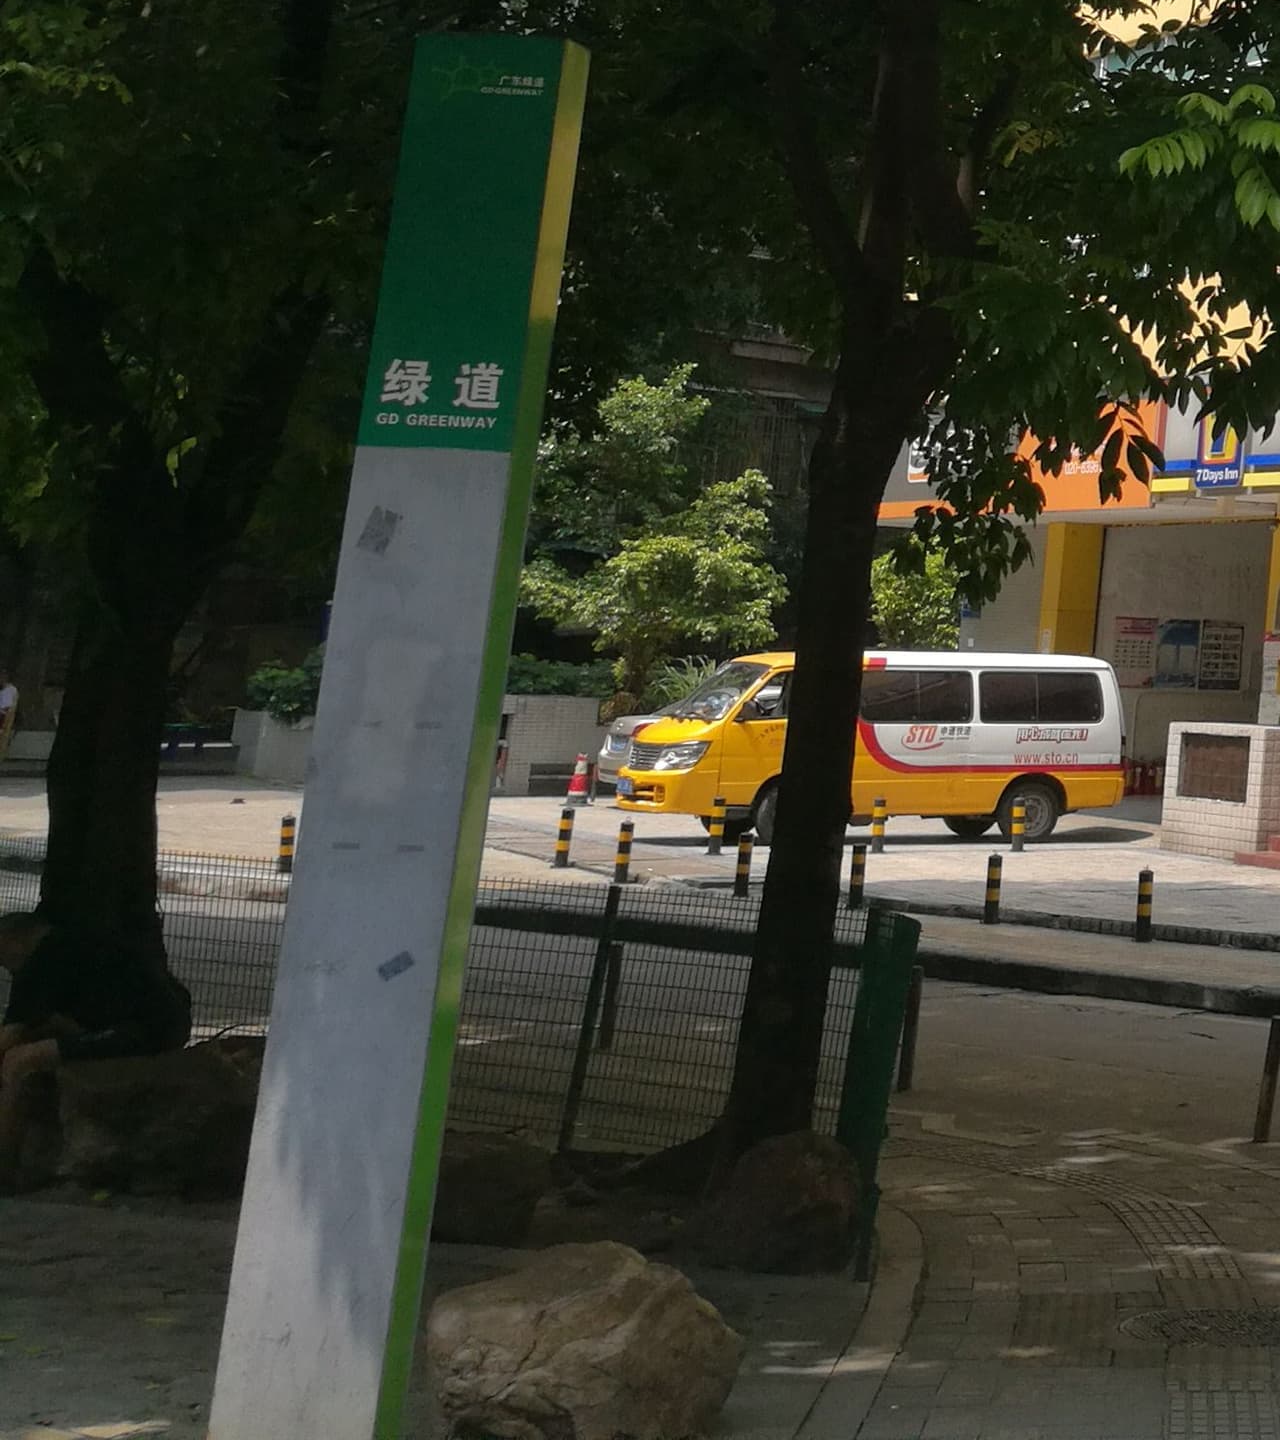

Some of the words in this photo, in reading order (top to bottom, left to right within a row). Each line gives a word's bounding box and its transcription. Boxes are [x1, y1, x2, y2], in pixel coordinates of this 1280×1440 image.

[380, 359, 504, 409] 绿道
[376, 413, 399, 426] GD
[406, 414, 497, 430] GREENWAY
[1225, 467, 1238, 479] Inn
[1014, 751, 1079, 764] www.sto.cn
